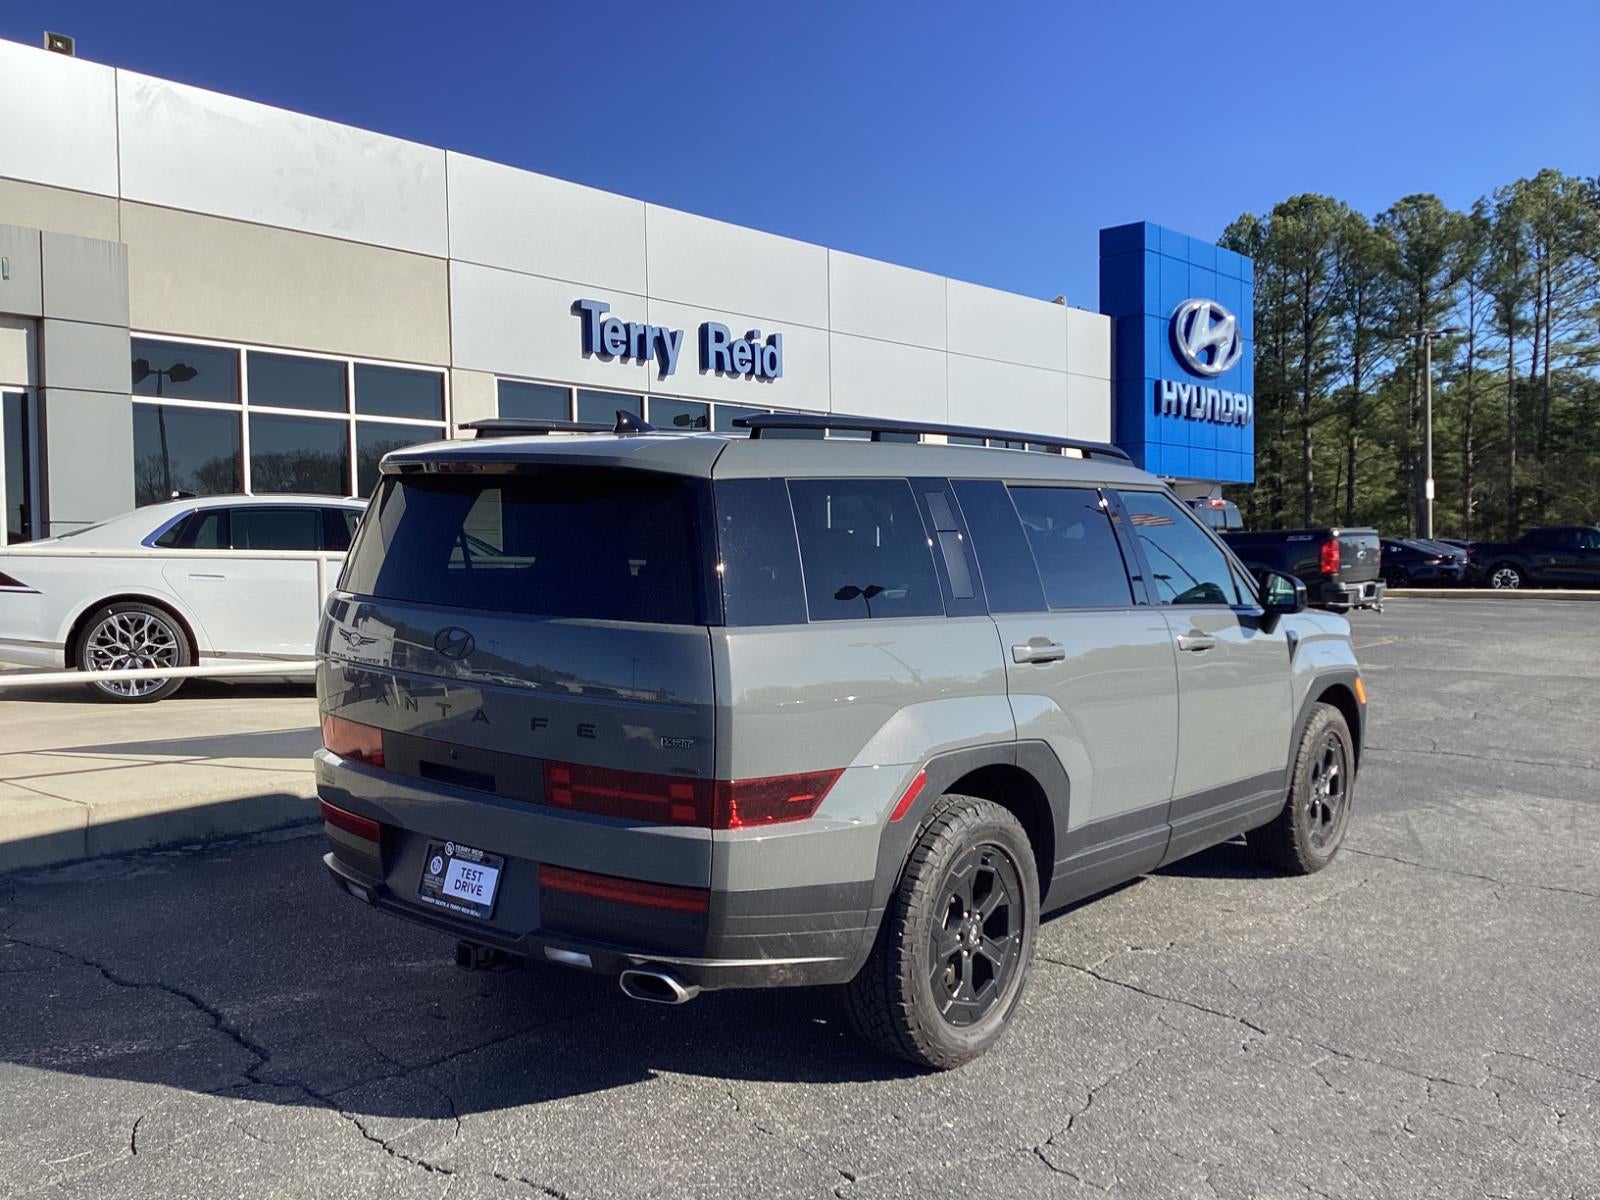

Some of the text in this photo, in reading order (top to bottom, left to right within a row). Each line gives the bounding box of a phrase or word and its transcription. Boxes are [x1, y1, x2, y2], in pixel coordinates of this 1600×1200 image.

[571, 299, 783, 383] Terry Reid
[1155, 379, 1253, 426] HYUNDAI
[531, 717, 596, 739] FE
[462, 867, 484, 882] TEST
[454, 879, 483, 896] DRIVE
